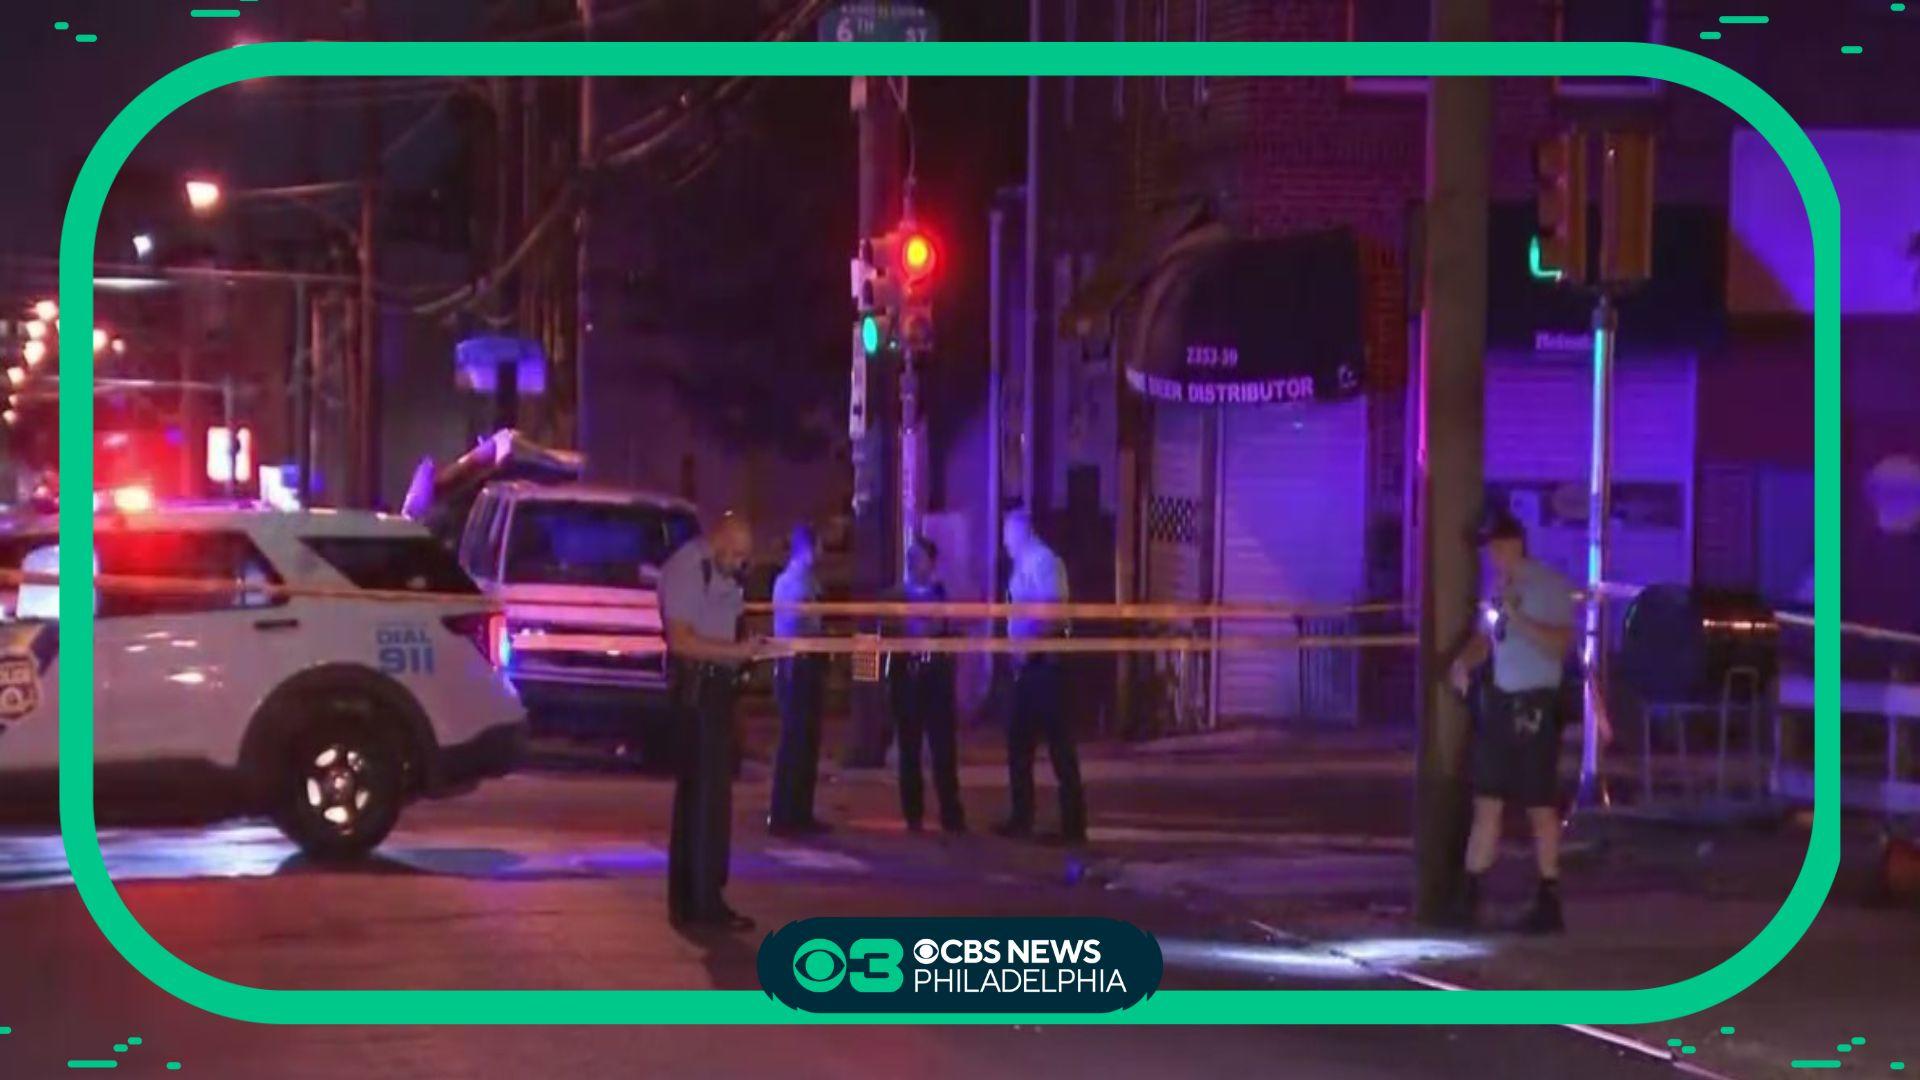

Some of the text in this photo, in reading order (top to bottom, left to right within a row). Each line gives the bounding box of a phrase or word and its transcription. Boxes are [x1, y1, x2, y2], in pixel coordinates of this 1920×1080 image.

[1188, 376, 1314, 402] DISTRIBUTOR
[377, 628, 431, 645] DIAL
[379, 647, 434, 675] 911
